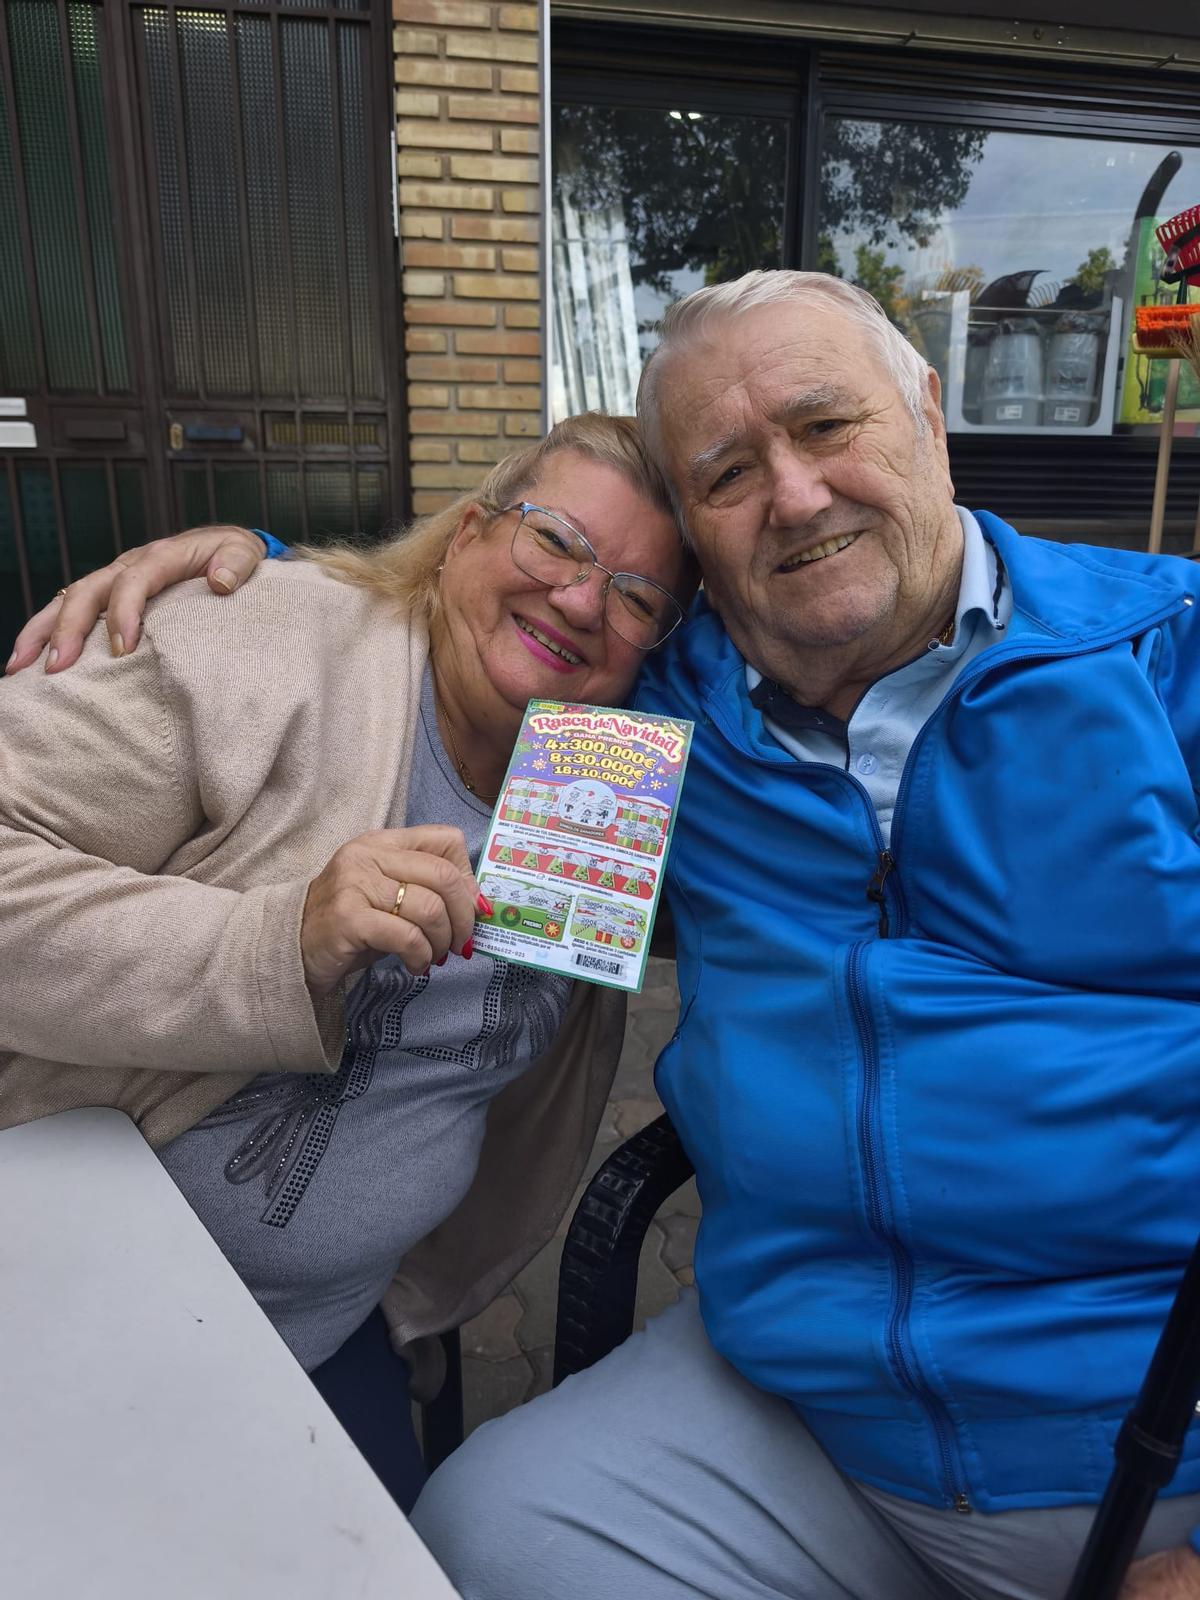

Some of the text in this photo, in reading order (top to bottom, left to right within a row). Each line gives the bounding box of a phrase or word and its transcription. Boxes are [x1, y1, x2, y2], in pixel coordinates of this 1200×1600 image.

[533, 715, 681, 759] Rasca de Navidad
[573, 732, 634, 747] GANA PREMIOS
